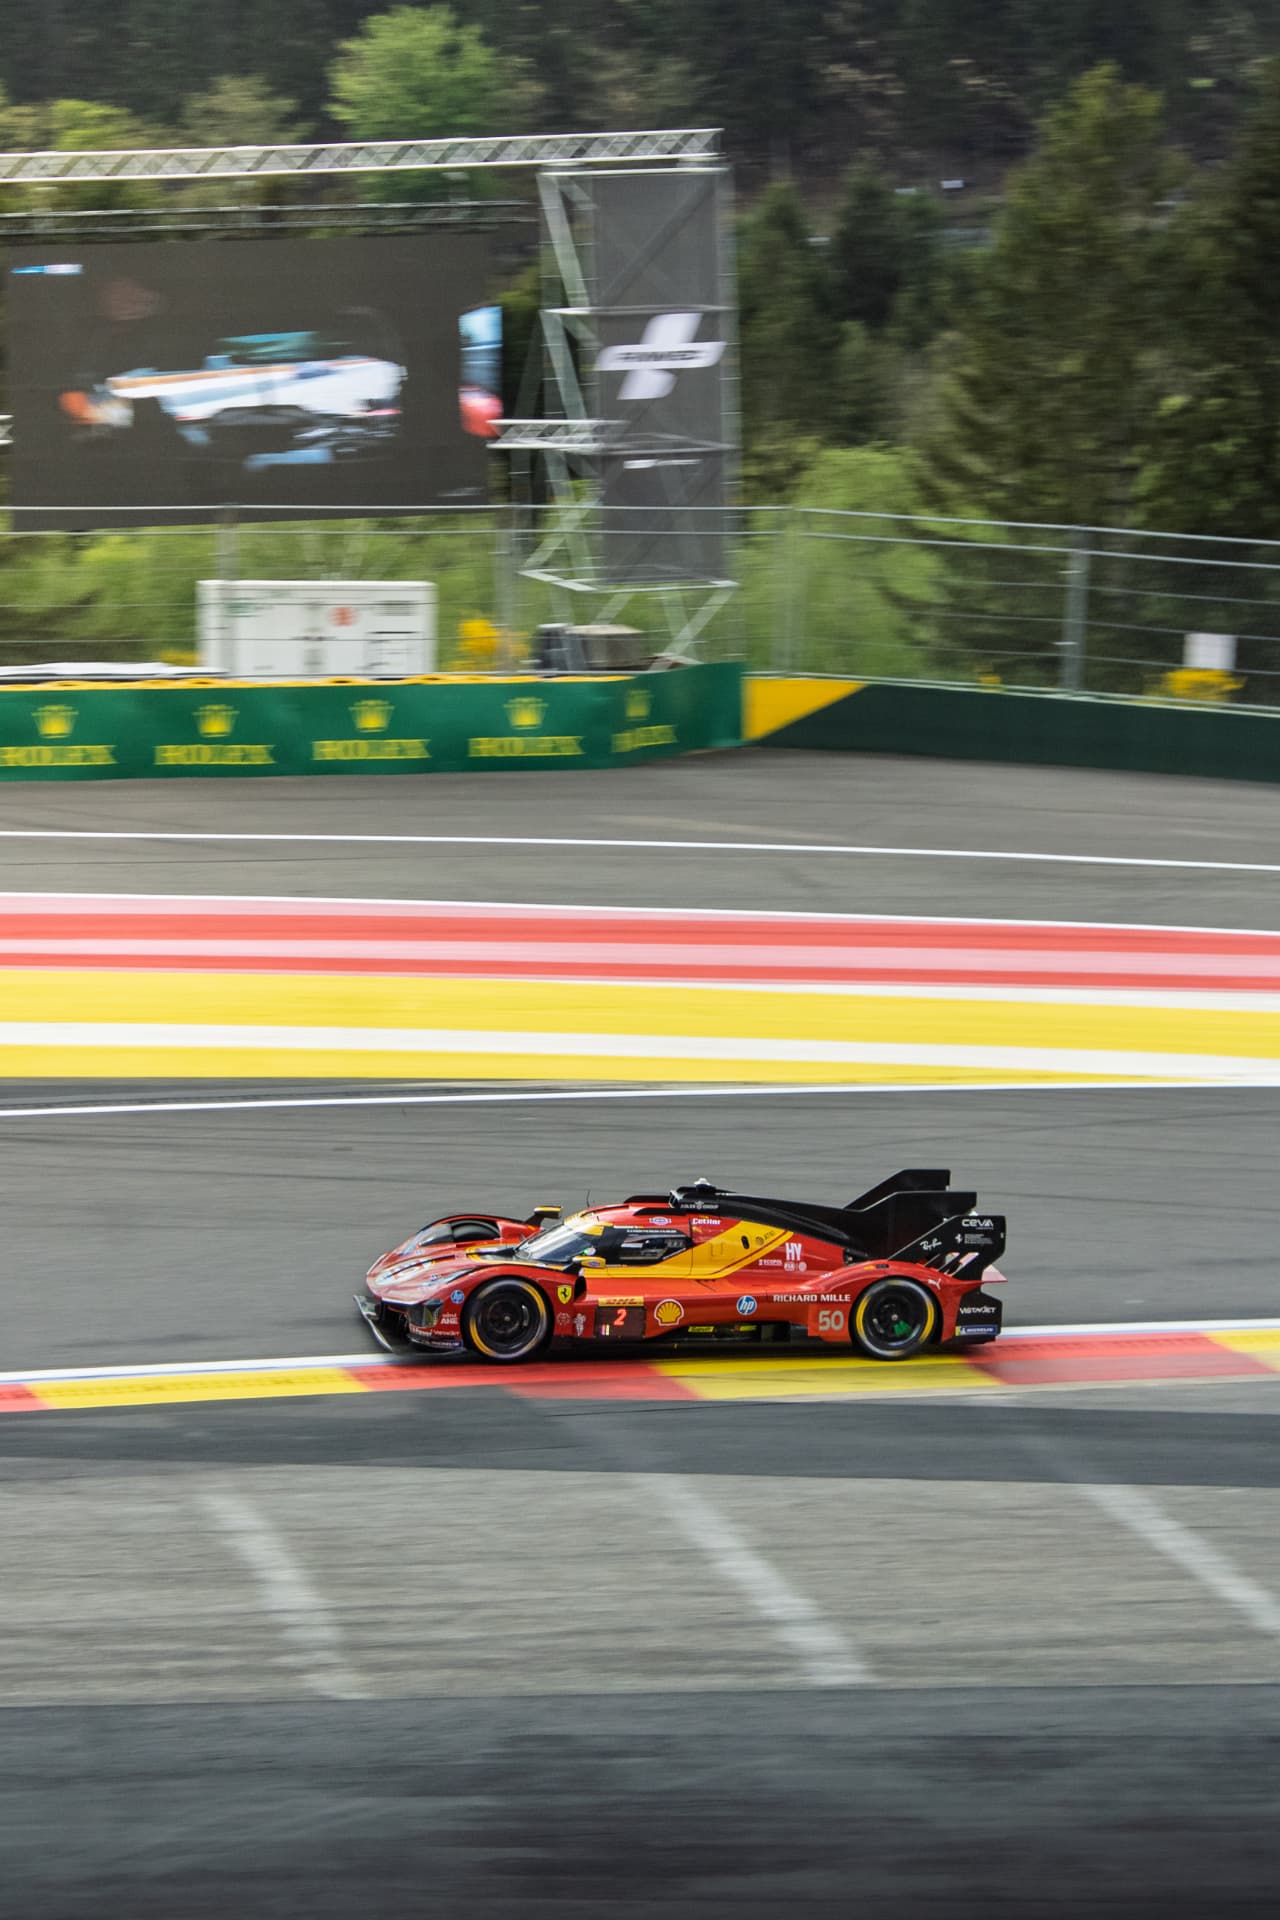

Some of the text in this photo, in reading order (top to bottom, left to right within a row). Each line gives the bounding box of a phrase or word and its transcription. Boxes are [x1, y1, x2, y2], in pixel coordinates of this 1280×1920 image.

[740, 1296, 755, 1315] hp
[820, 1294, 851, 1302] MILLE
[614, 1308, 627, 1326] 2
[819, 1311, 844, 1331] 50
